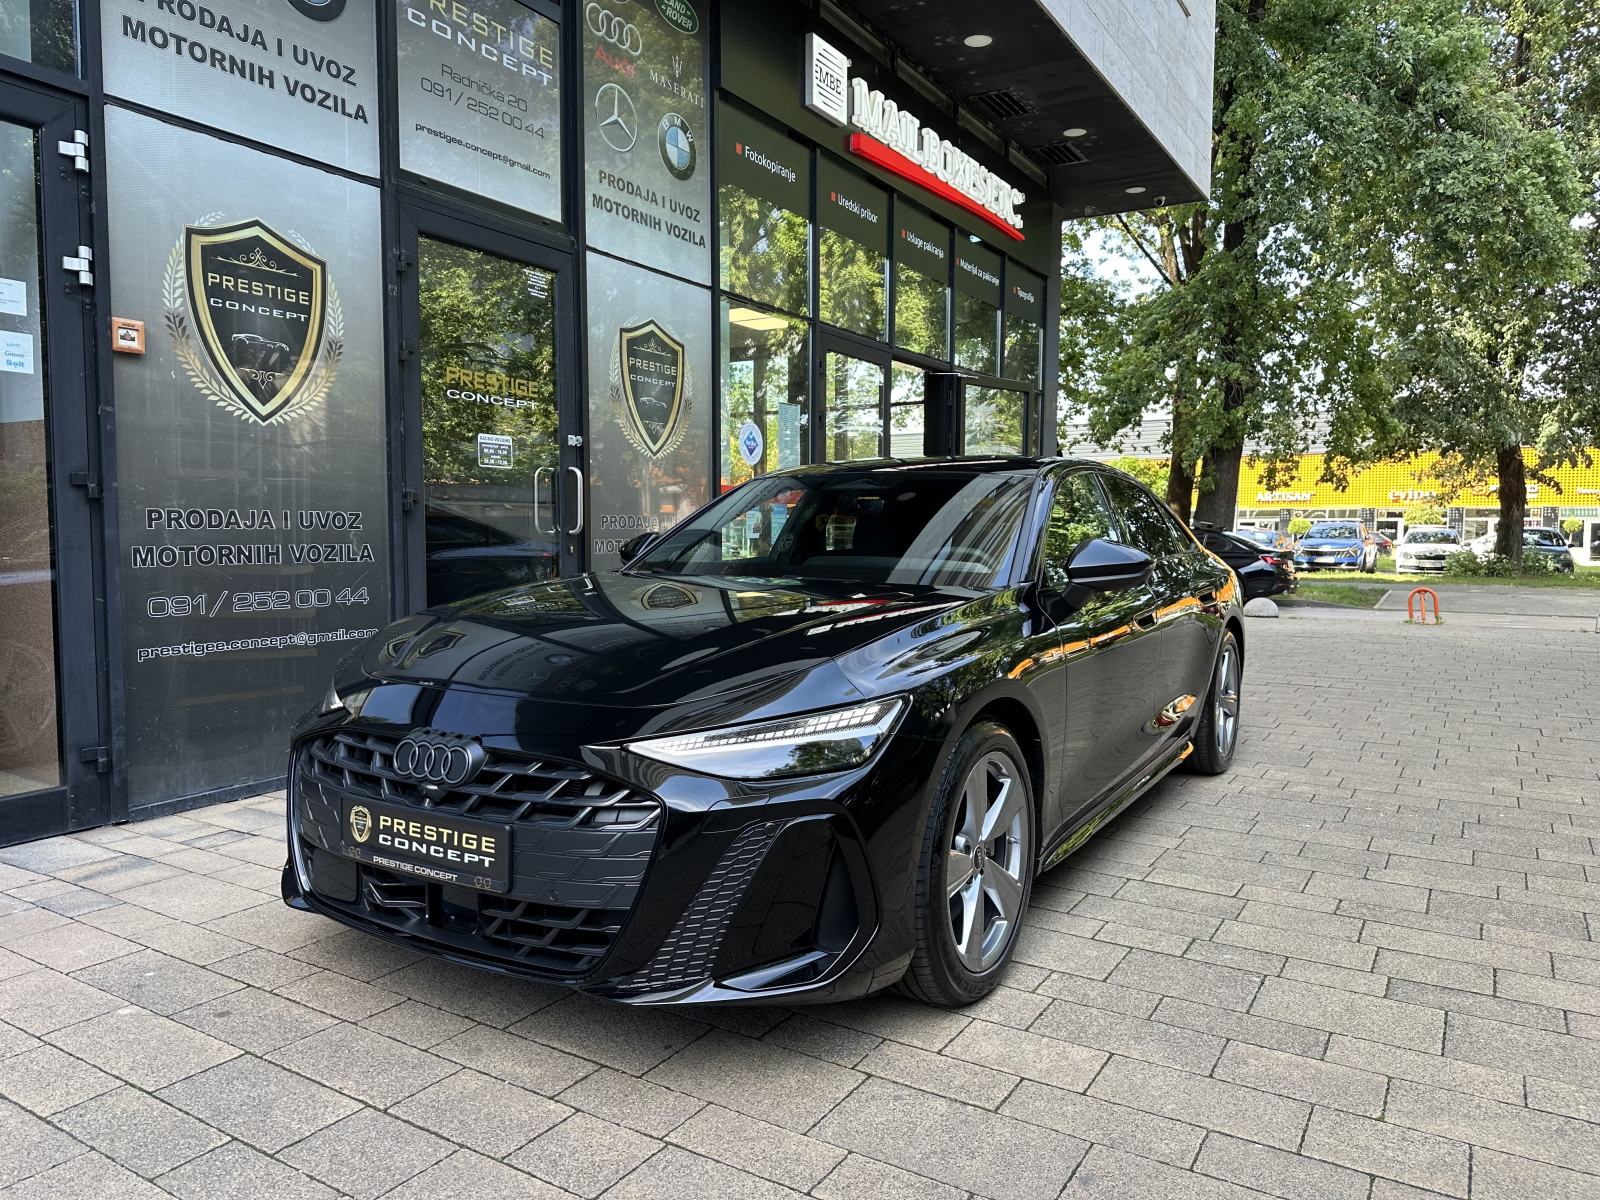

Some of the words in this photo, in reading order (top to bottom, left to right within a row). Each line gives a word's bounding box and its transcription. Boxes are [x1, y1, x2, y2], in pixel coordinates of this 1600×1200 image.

[664, 0, 686, 14] AND
[666, 6, 693, 31] ROVER
[138, 0, 268, 51] RODAJA
[276, 37, 283, 57] I
[292, 44, 357, 87] UVOZ
[407, 7, 553, 86] CONCEPT
[430, 0, 552, 70] RESTIGE
[122, 14, 275, 90] MOTORNIH
[283, 74, 369, 125] VOZILA
[819, 66, 842, 96] MBE
[441, 64, 505, 102] Radnička
[507, 94, 528, 113] 20
[649, 69, 704, 108] MASERATI
[467, 97, 499, 121] 252
[502, 111, 523, 130] 00
[525, 123, 545, 140] 44
[415, 123, 551, 180] prestigee.concept@gmail.com
[852, 77, 923, 167] MAIL
[921, 127, 988, 206] BOXES
[744, 145, 796, 183] Fotokopiranje
[599, 169, 658, 206] PRODAJA
[662, 195, 666, 209] I
[669, 199, 701, 223] UVOZ
[837, 193, 860, 215] Uredski
[860, 207, 878, 224] pribor
[592, 193, 661, 231] MOTORNIH
[665, 220, 706, 249] VOZILA
[207, 272, 310, 305] PRESTIGE
[210, 297, 309, 322] CONCEPT
[446, 366, 539, 398] PRESTIGE
[629, 357, 677, 376] PRESTIGE
[630, 373, 676, 388] CONCEPT
[446, 389, 540, 410] CONCEPT
[145, 508, 276, 530] PRODAJA
[282, 510, 290, 530] I
[298, 511, 363, 531] UVOZ
[131, 544, 282, 568] MOTORNIH
[288, 543, 375, 564] VOZILA
[232, 591, 290, 612] 252
[295, 588, 331, 608] 00
[335, 587, 370, 606] 44
[137, 629, 378, 663] prestigee.concept@gmail.com
[378, 834, 496, 868] CONCEPT
[379, 815, 496, 854] PRESTIGE
[373, 855, 414, 872] PRESTIGE
[414, 865, 458, 882] CONCEPT
